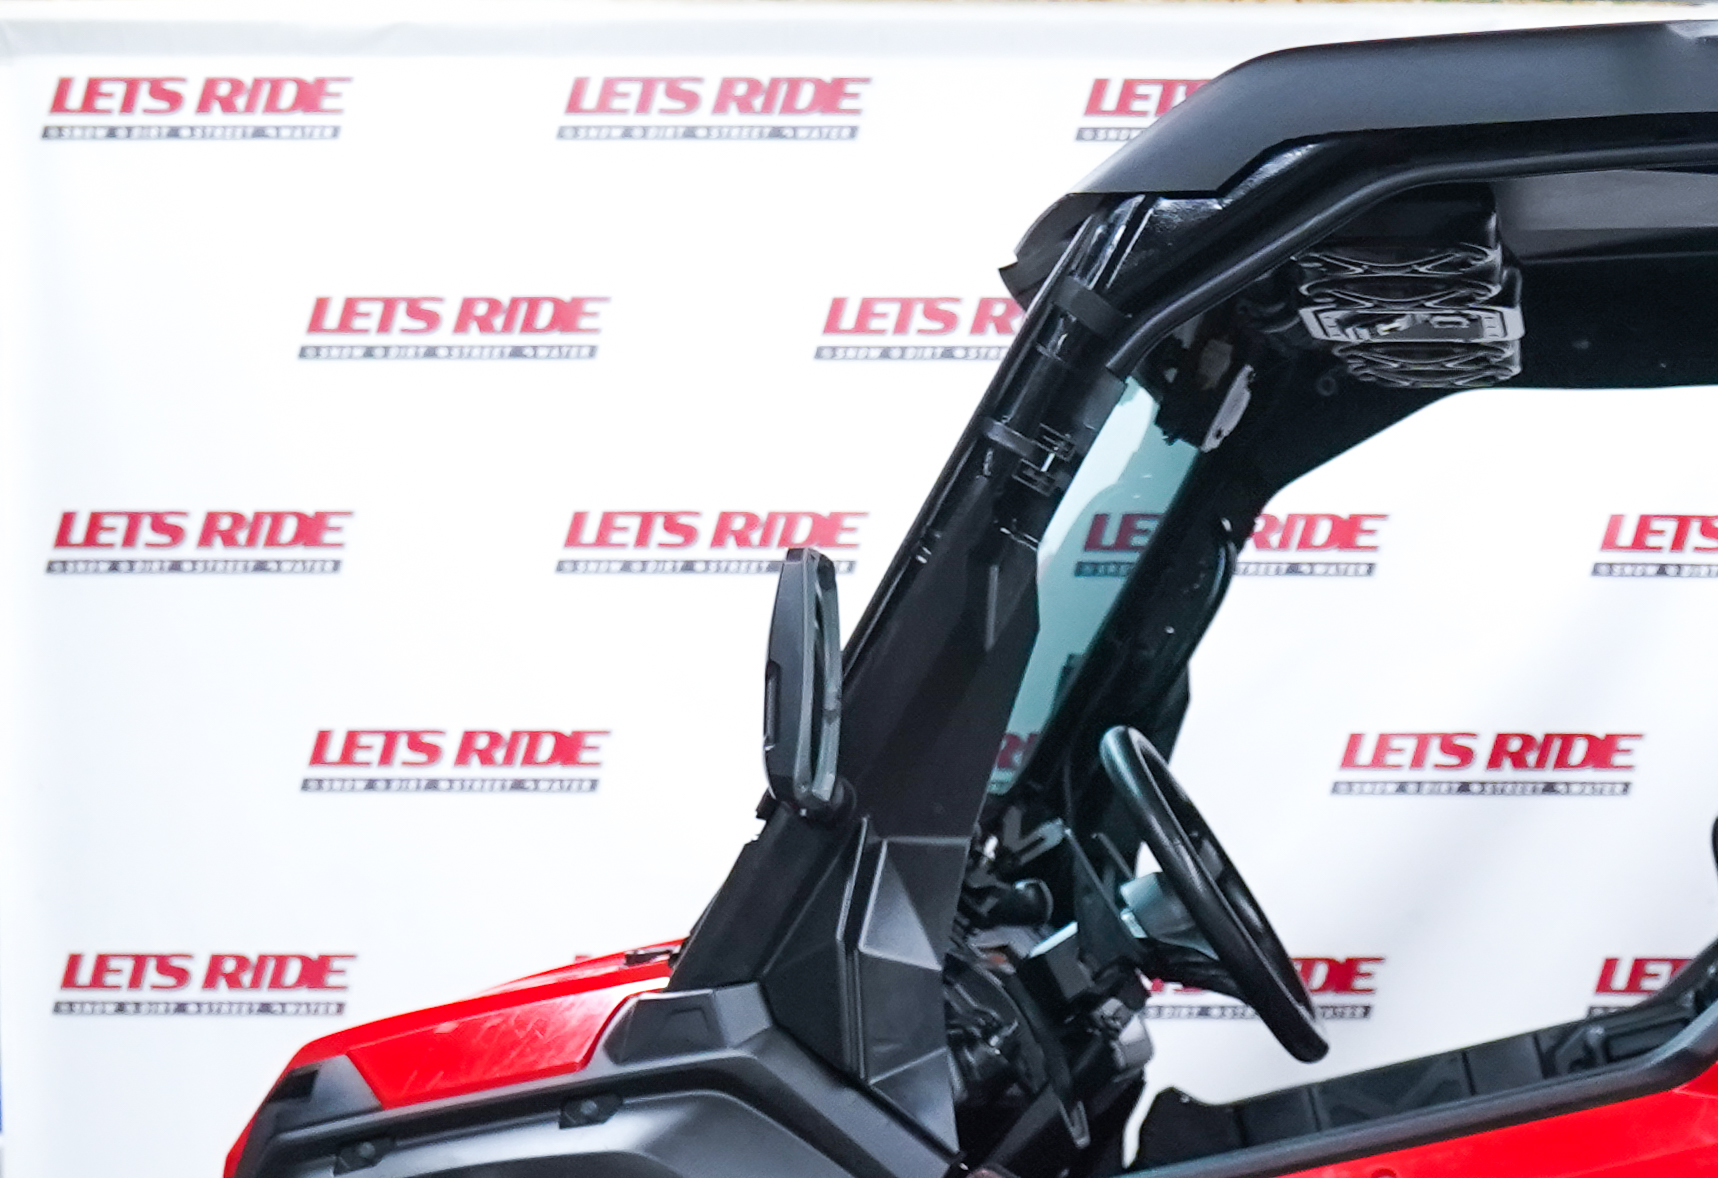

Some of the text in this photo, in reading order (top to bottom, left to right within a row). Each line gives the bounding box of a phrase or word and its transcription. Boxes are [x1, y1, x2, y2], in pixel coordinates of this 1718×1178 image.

[49, 77, 351, 115] LETS RIDE
[565, 78, 871, 115] LETS RIDE
[307, 297, 610, 334] LETS RIDE
[823, 297, 962, 335] LETS
[53, 511, 353, 549] LETS RIDE
[563, 511, 868, 549] LETS RIDE
[1084, 514, 1165, 551] LE
[309, 729, 610, 767] LETS RIDE
[1340, 732, 1644, 770] LETS RIDE
[61, 953, 357, 991] LETS RIDE
[1292, 957, 1384, 994] DE
